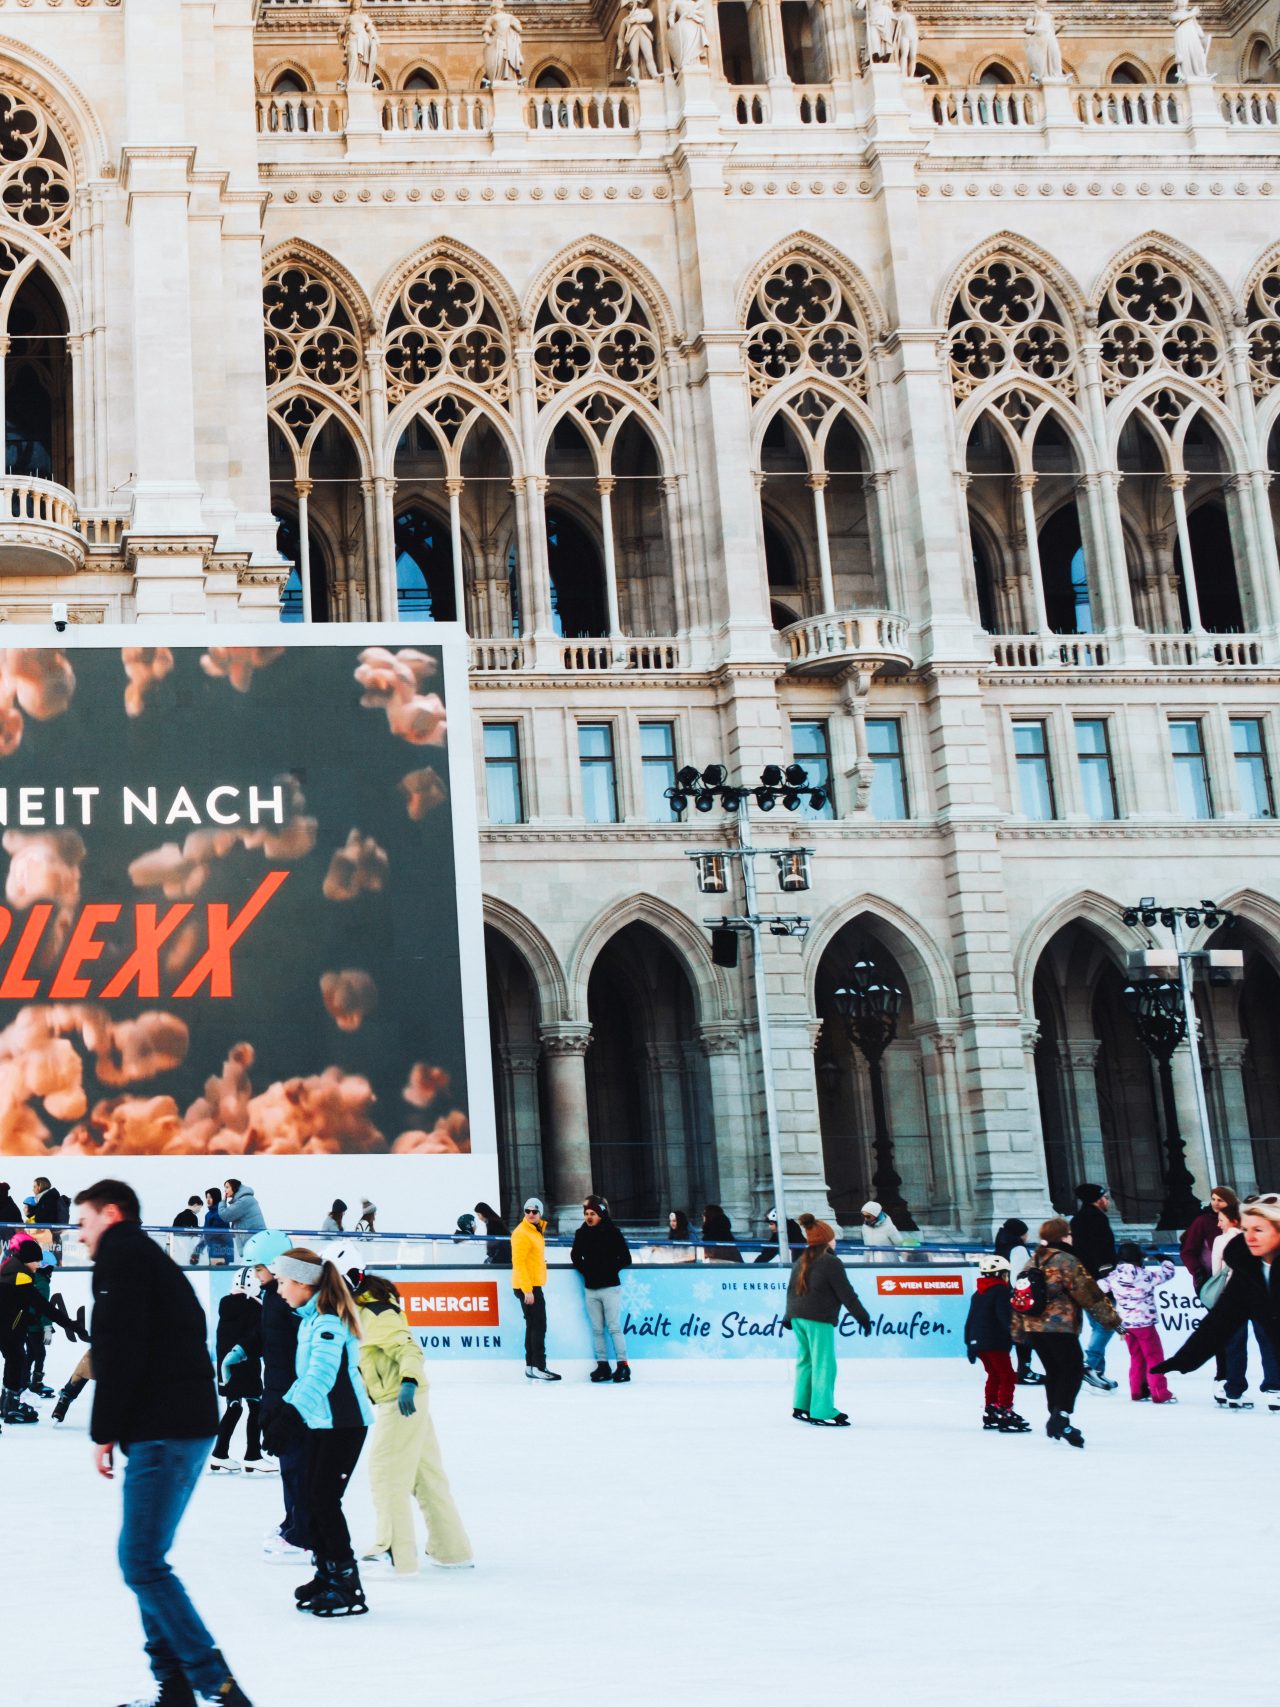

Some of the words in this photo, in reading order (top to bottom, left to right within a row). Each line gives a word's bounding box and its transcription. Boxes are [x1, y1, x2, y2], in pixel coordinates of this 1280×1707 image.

[122, 785, 284, 825] NACH
[722, 1282, 738, 1291] DIE
[743, 1282, 787, 1291] ENERGIE
[898, 1281, 923, 1290] WIEN
[923, 1281, 960, 1290] ENERGIE
[410, 1296, 490, 1312] ENERGIE
[622, 1312, 672, 1338] hält
[679, 1312, 712, 1338] die
[1160, 1312, 1201, 1332] Wie
[419, 1335, 451, 1348] VON
[460, 1335, 502, 1348] WIEN
